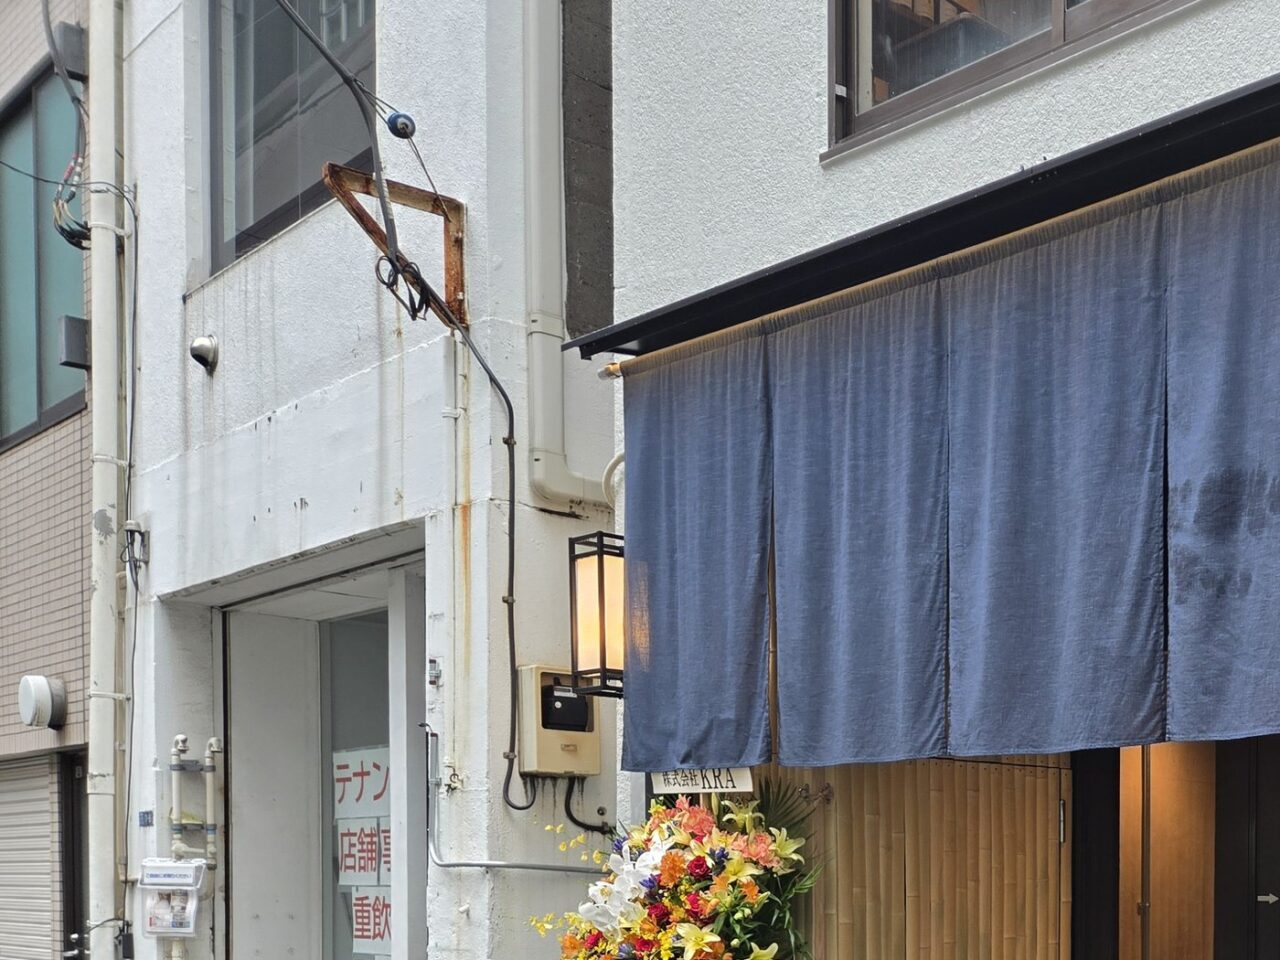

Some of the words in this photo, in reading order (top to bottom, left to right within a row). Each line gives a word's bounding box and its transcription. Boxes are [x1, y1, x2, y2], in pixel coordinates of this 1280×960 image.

[335, 760, 390, 804] テナン
[353, 895, 391, 941] 重飲
